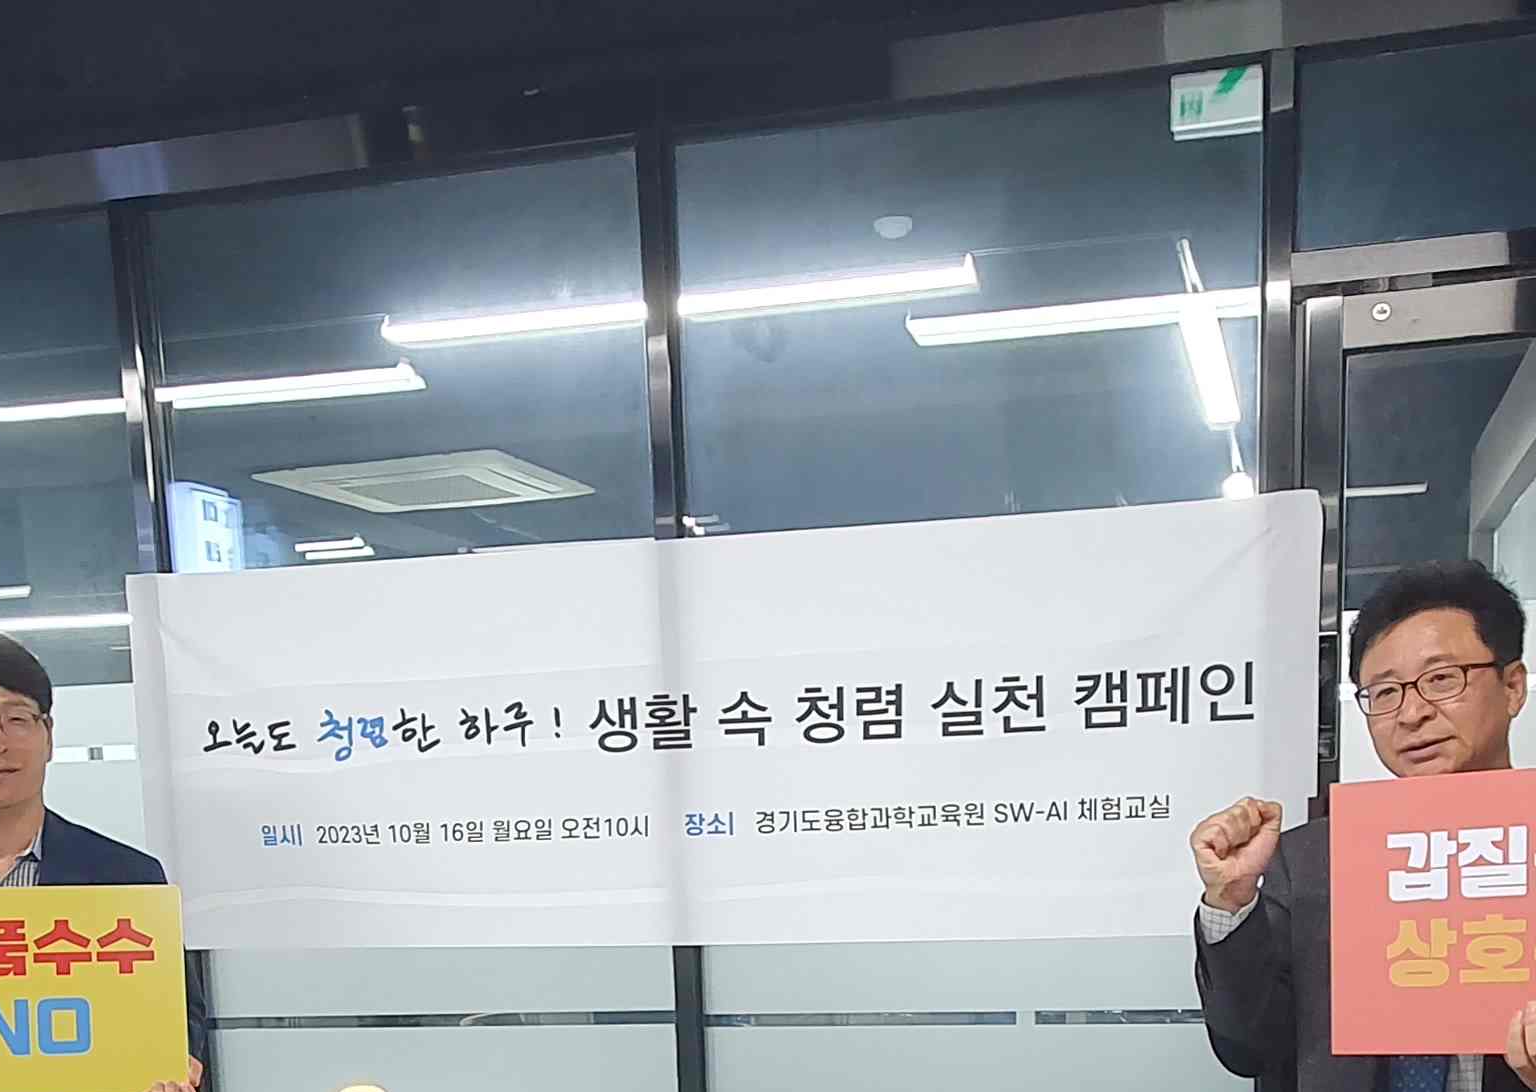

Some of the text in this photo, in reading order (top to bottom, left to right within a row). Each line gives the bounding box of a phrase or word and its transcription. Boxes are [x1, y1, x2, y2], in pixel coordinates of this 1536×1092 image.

[203, 719, 297, 755] 오늘도
[317, 708, 441, 762] 청렴한
[589, 694, 698, 753] 생활
[718, 691, 772, 747] 속
[796, 683, 903, 744] 청렴
[931, 675, 1046, 737] 실천
[1074, 661, 1255, 730] 캠페인
[316, 824, 381, 845] 2023년
[388, 822, 430, 844] 10월
[440, 821, 484, 843] 16일
[493, 818, 552, 842] 월요일
[561, 815, 649, 840] 오전10시
[756, 802, 985, 834] 경기도융합과학교육원
[994, 801, 1068, 824] SW-AI
[1078, 795, 1170, 821] 체험교실
